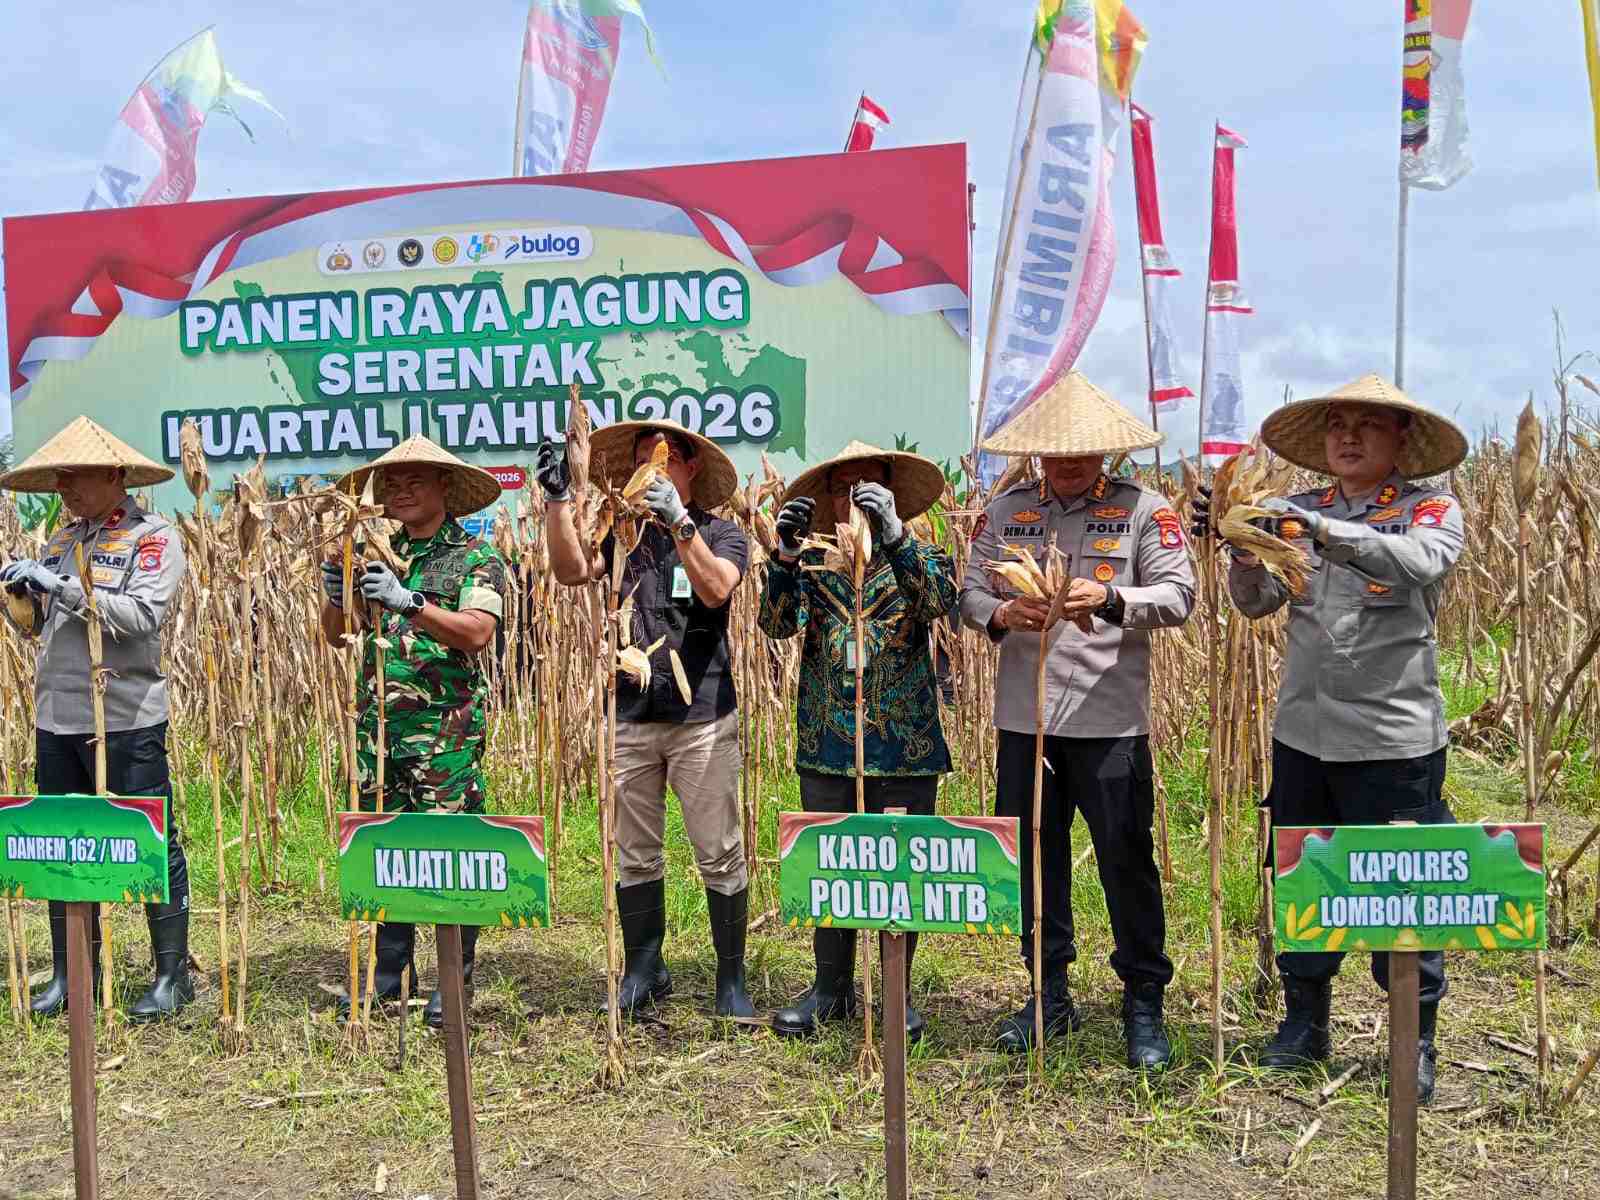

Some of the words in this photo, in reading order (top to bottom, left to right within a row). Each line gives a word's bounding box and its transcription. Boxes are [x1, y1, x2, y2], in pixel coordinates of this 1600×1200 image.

[522, 233, 580, 256] bulog
[185, 297, 352, 348] PANEN
[370, 288, 509, 337] RAYA
[523, 275, 743, 331] JAGUNG
[317, 340, 598, 396] SERENTAK
[1086, 523, 1131, 534] POLRI
[92, 553, 127, 567] POLRI
[7, 836, 66, 860] DANREM
[69, 838, 97, 862] 162
[110, 839, 137, 863] WB
[818, 834, 897, 872] KARO
[910, 836, 977, 873] SDM
[1350, 849, 1468, 883] KAPOLRES
[375, 848, 454, 889] KAJATI
[458, 850, 507, 891] NTB
[810, 878, 912, 921] POLDA
[923, 882, 988, 923] NTB
[1320, 895, 1419, 927] LOMBOK
[1423, 893, 1500, 926] BARAT
